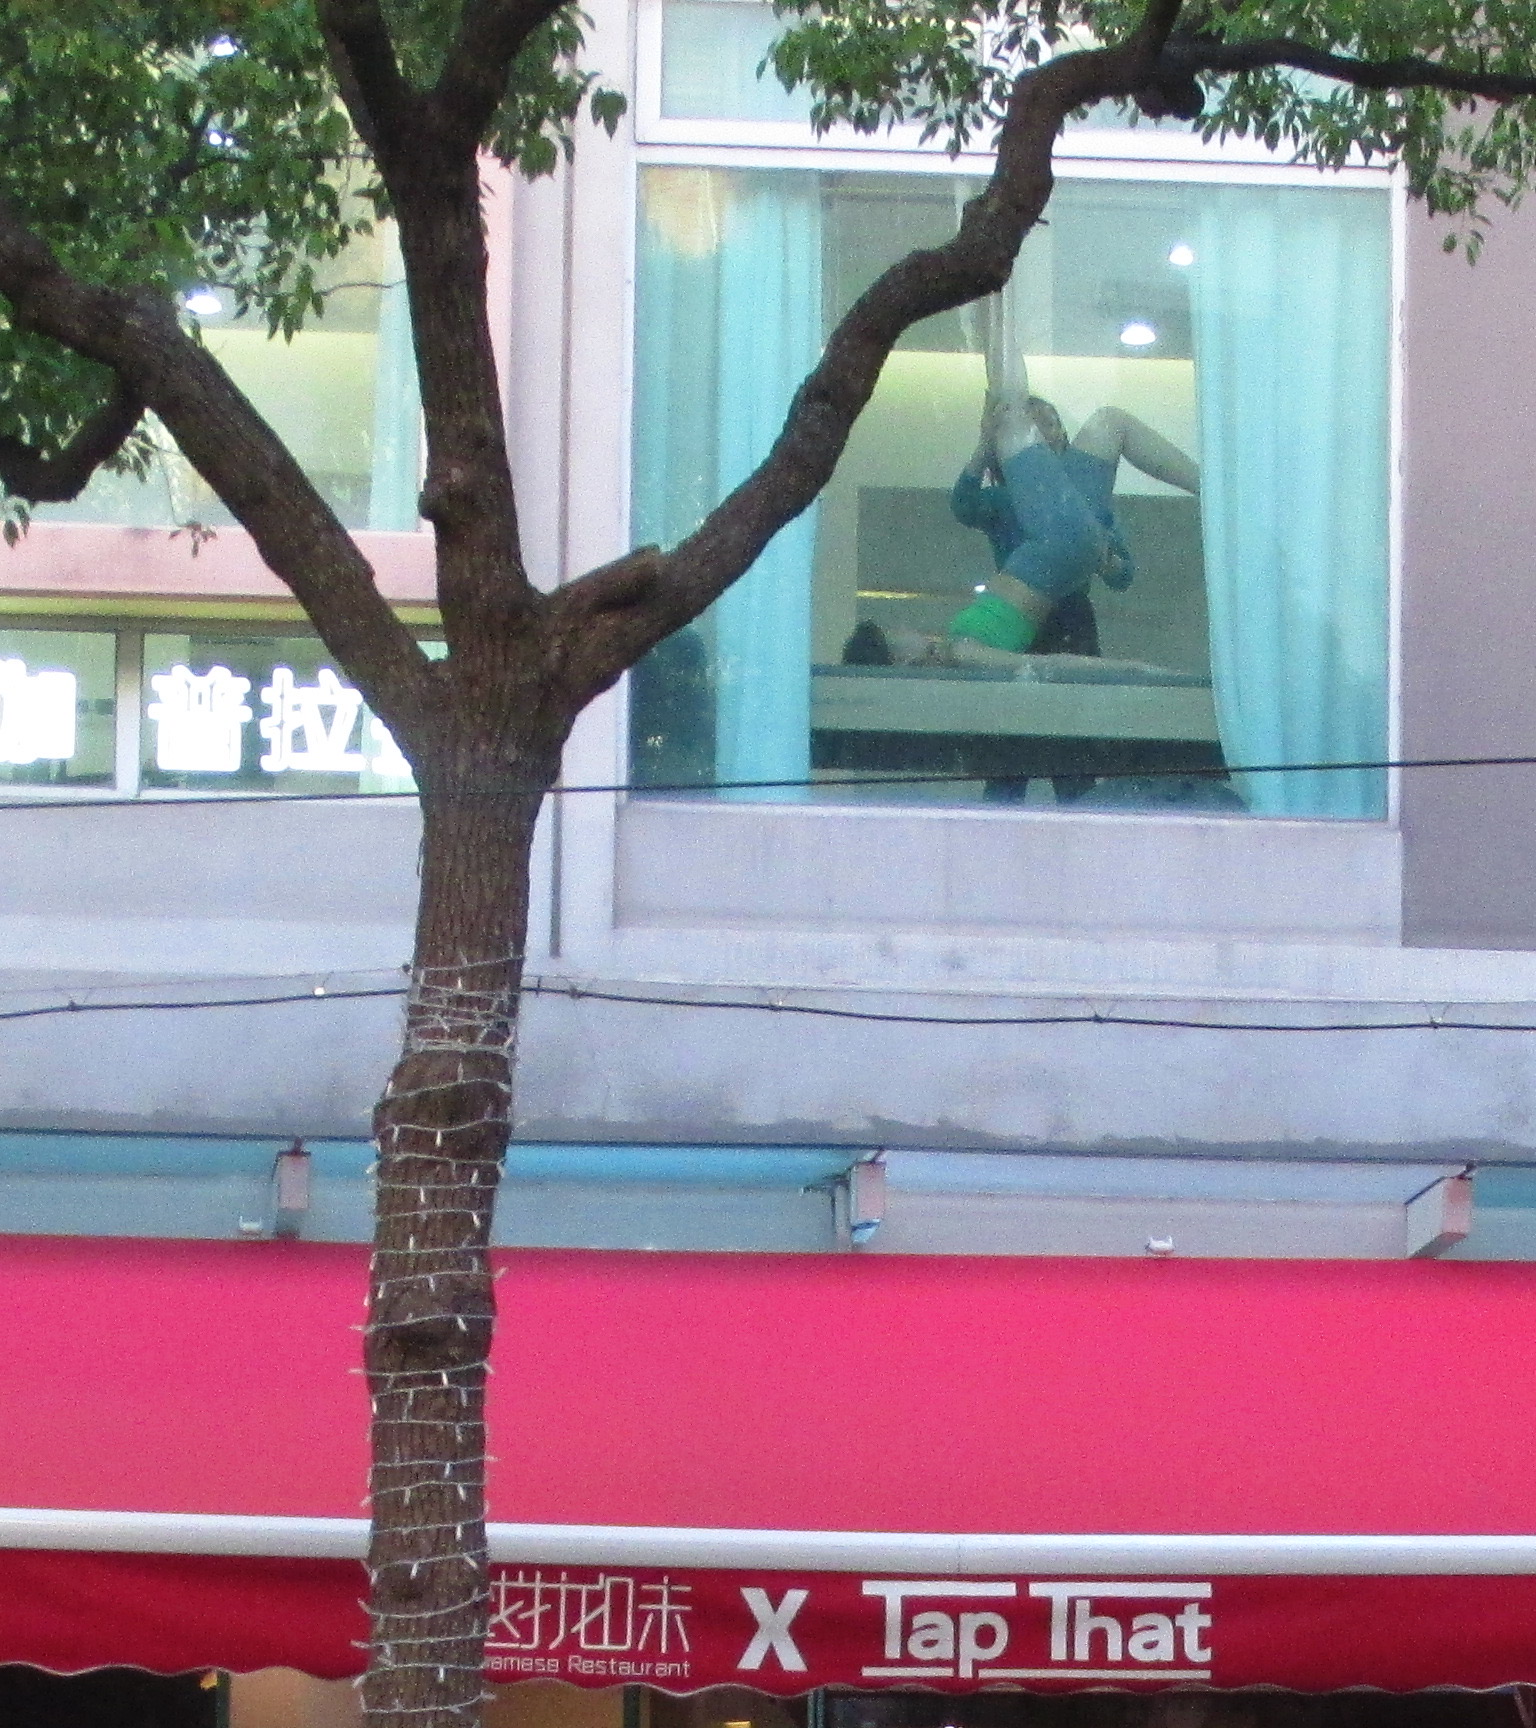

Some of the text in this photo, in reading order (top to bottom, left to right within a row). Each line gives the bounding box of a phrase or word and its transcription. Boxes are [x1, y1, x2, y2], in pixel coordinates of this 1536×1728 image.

[150, 664, 414, 794] 普拉
[567, 1655, 691, 1677] Restaurant
[863, 1581, 1016, 1678] Tap
[1029, 1581, 1212, 1664] That
